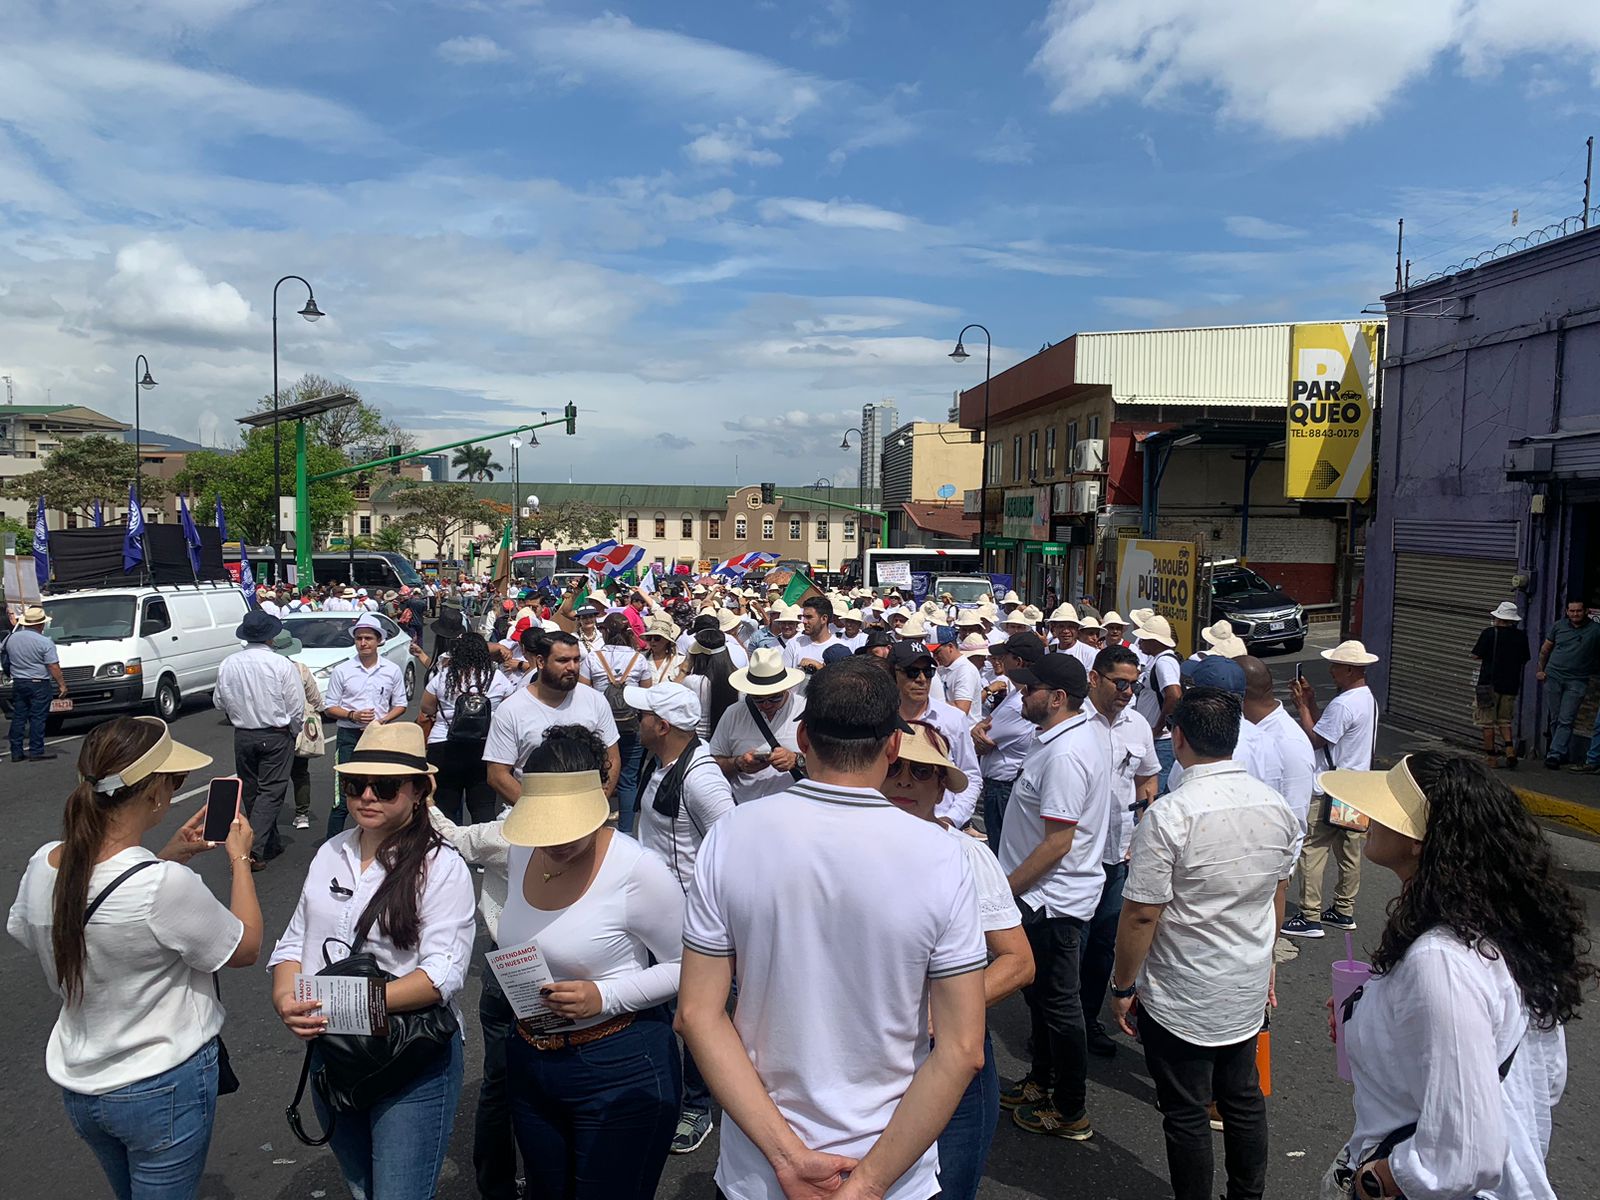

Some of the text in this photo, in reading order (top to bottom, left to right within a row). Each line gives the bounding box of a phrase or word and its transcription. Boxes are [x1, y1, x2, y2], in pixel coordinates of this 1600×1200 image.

[1292, 380, 1341, 401] PAR
[1289, 402, 1361, 427] QUEO
[1291, 428, 1360, 438] TEL: 8843-0178
[1153, 558, 1189, 577] PARQUEO
[1138, 570, 1188, 607] PÚBLICO
